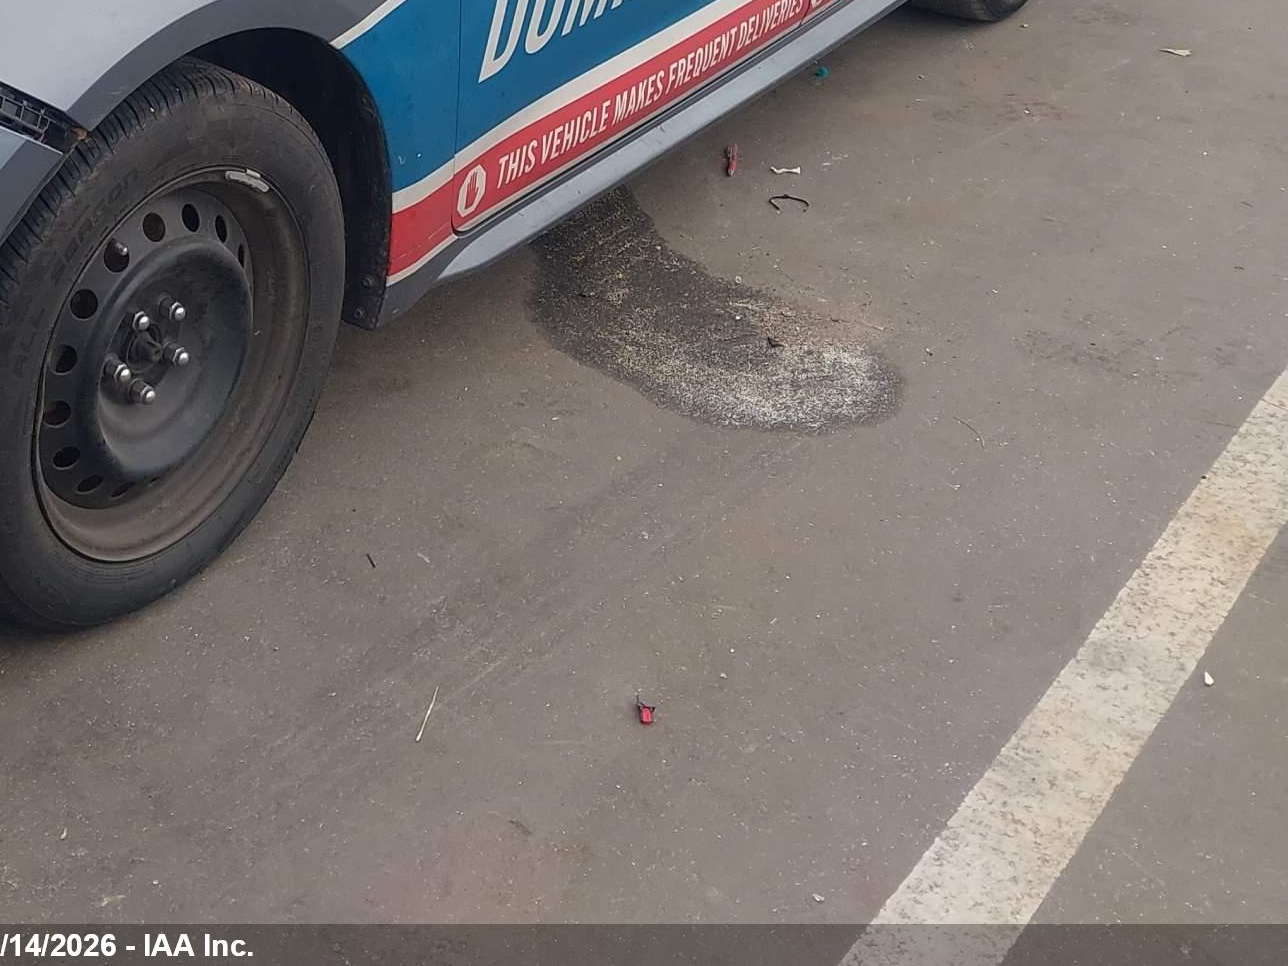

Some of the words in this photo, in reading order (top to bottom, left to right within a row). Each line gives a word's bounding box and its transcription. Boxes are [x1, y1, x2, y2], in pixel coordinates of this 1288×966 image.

[497, 139, 538, 189] THIS
[541, 100, 611, 164] VEHICLE
[612, 70, 664, 125] MAKES
[665, 27, 738, 93] FREQUENT
